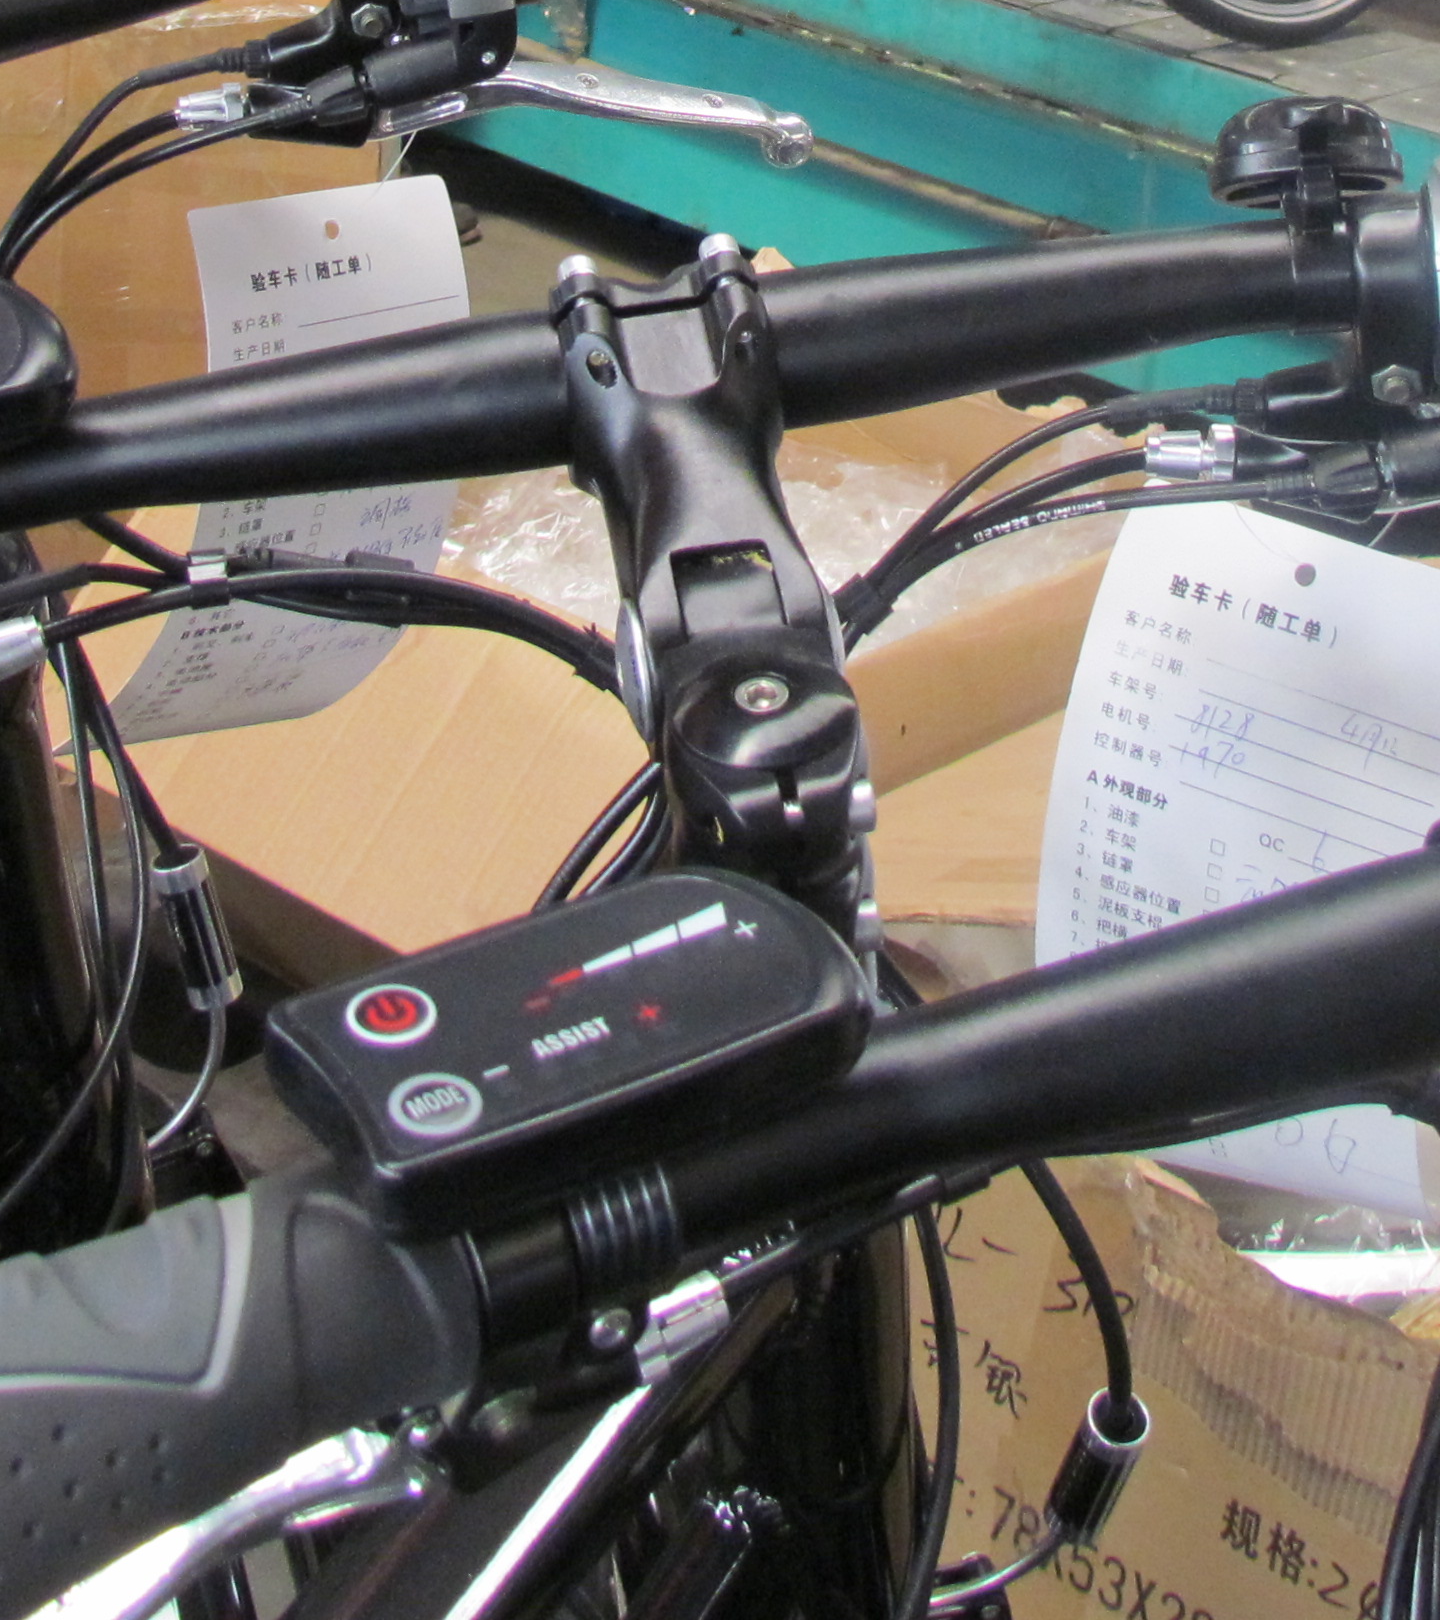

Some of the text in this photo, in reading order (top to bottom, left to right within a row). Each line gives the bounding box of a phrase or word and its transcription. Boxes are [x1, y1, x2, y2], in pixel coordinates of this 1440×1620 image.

[1258, 833, 1285, 853] QC
[531, 1017, 611, 1059] ASSIST
[405, 1085, 466, 1120] MODE
